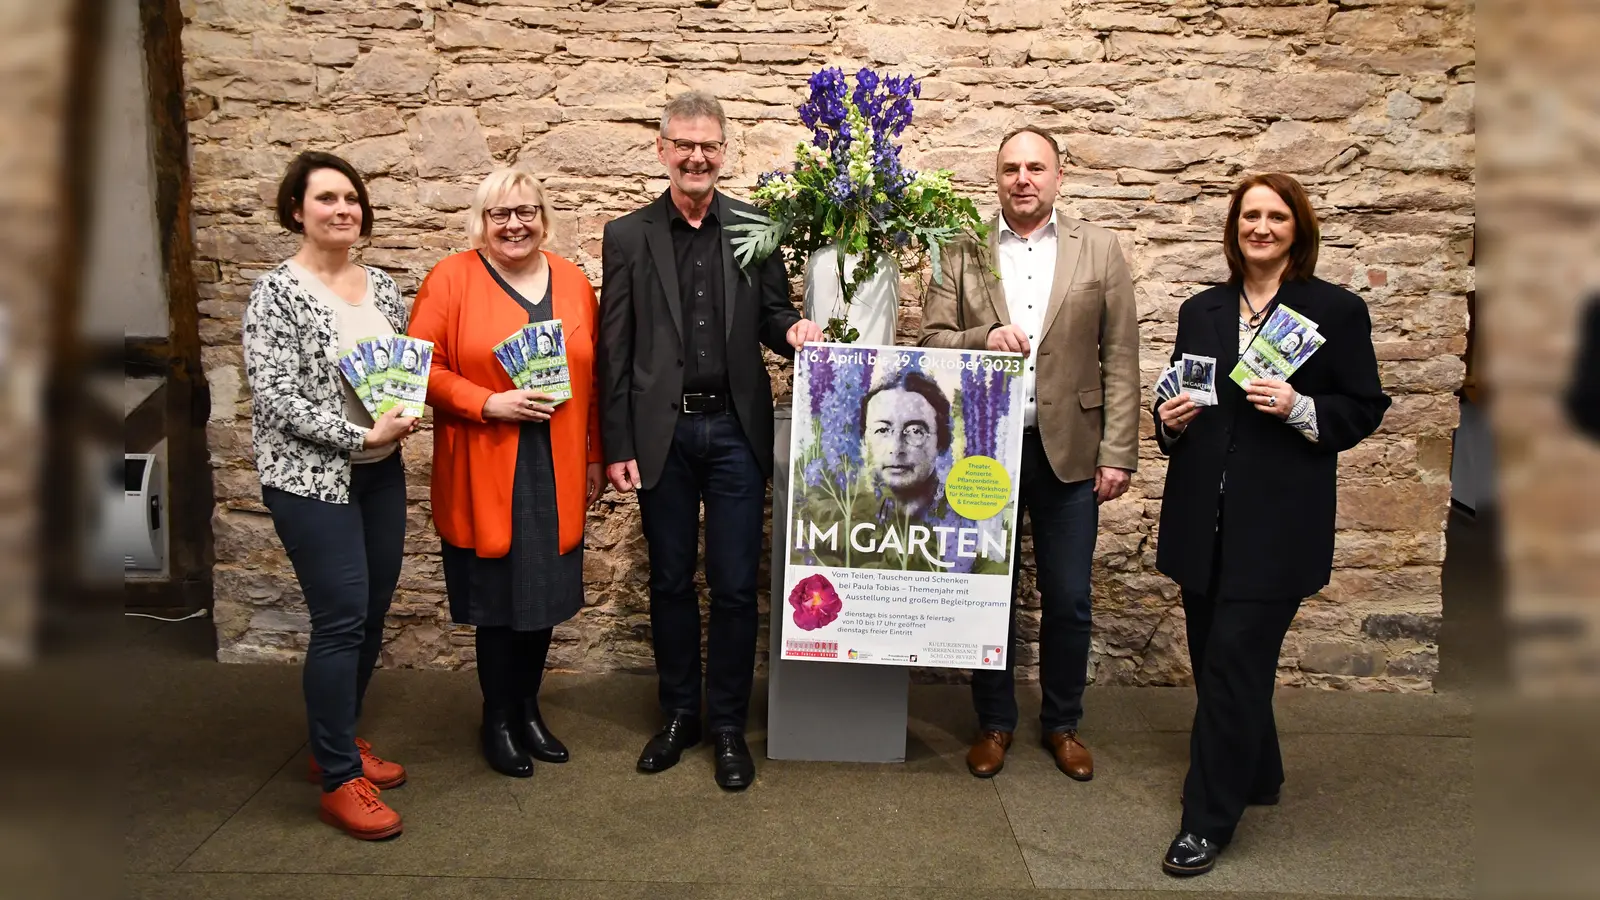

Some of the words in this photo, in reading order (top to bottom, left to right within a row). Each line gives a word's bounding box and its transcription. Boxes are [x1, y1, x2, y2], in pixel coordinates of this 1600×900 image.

[803, 349, 822, 363] 16.
[826, 351, 863, 366] April
[868, 353, 890, 366] bis
[894, 353, 914, 367] 29.
[918, 355, 981, 371] Oktober
[984, 358, 1020, 372] 2023
[794, 519, 839, 551] IM
[850, 522, 1008, 568] GARTEN
[851, 572, 875, 580] Teilen,
[877, 573, 913, 581] Tauschen
[932, 576, 969, 584] Schenken
[853, 582, 874, 590] Paula
[909, 585, 954, 595] Themenjahr
[845, 594, 890, 603] Ausstellung
[909, 597, 939, 605] großem
[941, 598, 1007, 608] Begleitprogramm
[844, 611, 876, 619] dienstags
[889, 613, 918, 621] sonntags
[926, 614, 955, 623] feiertags
[837, 627, 868, 635] dienstags
